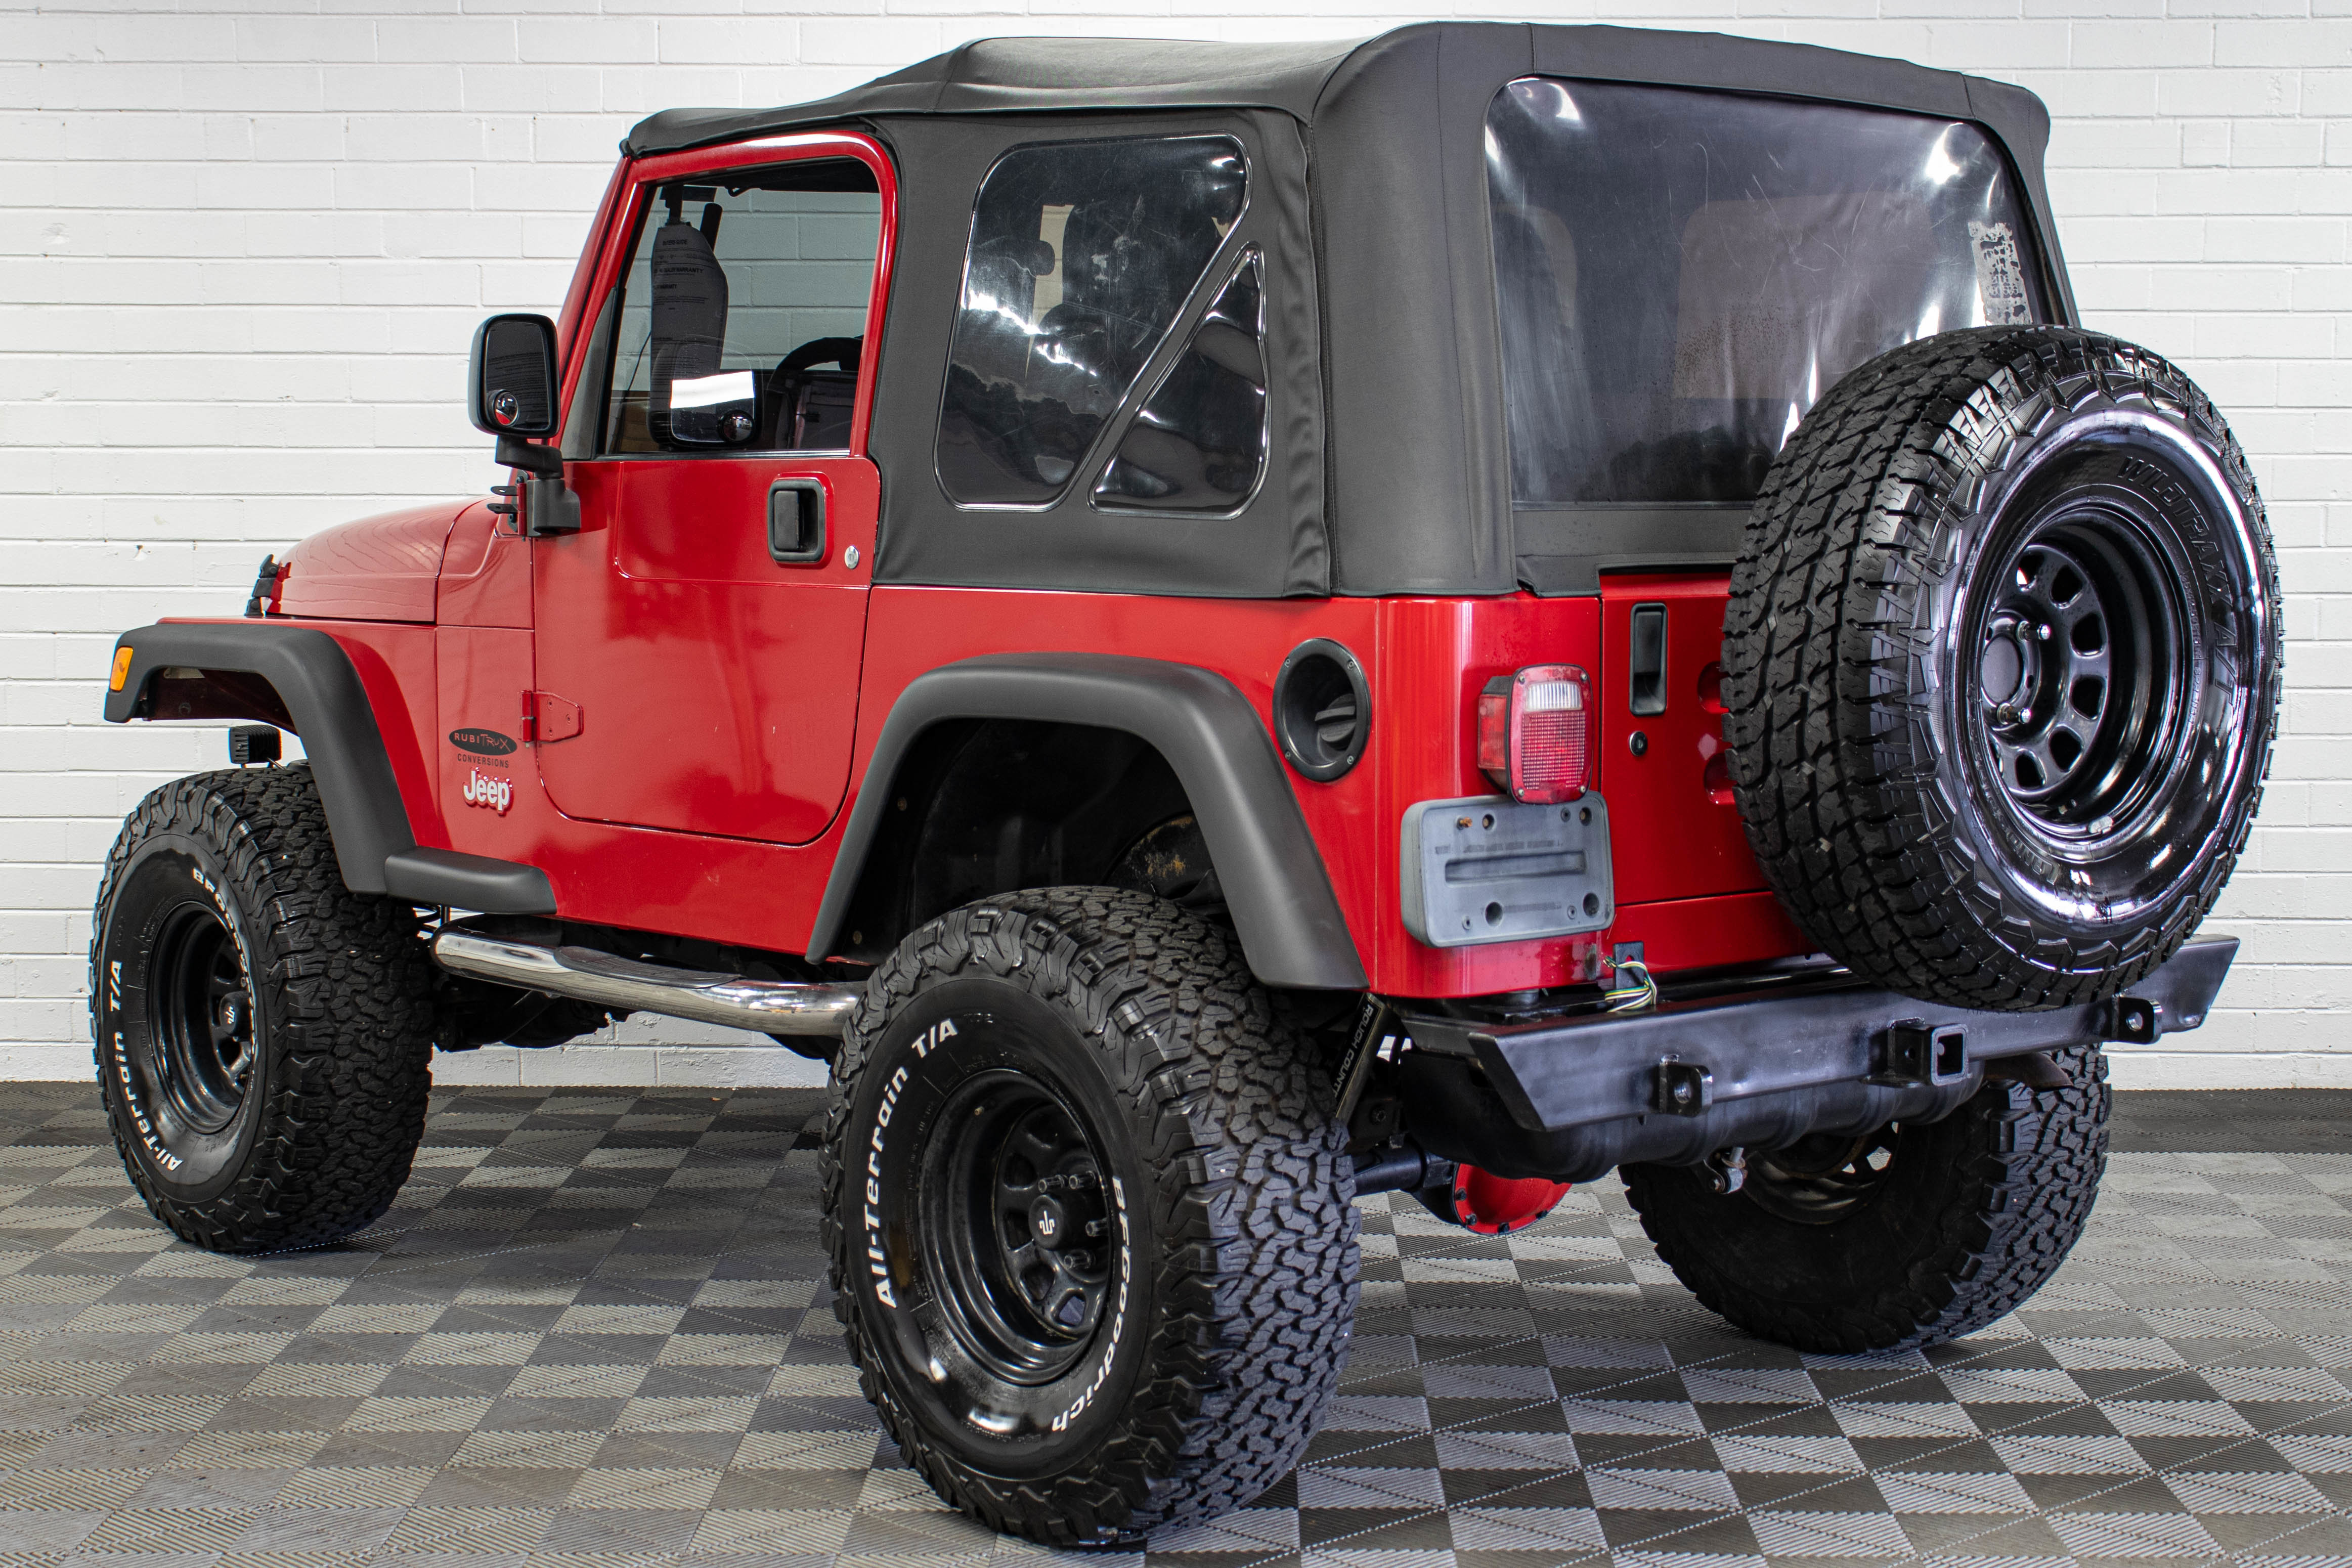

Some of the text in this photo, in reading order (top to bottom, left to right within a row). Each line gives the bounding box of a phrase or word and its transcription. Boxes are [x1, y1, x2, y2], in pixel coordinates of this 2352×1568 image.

[457, 753, 509, 768] CONVERSIONS
[463, 770, 510, 811] Jeep
[110, 961, 184, 1172] All-Terrain T/A
[1352, 1004, 1374, 1049] ROUGH
[864, 1018, 959, 1309] All-Terrain T/A
[1052, 1174, 1132, 1432] BFGoodrich
